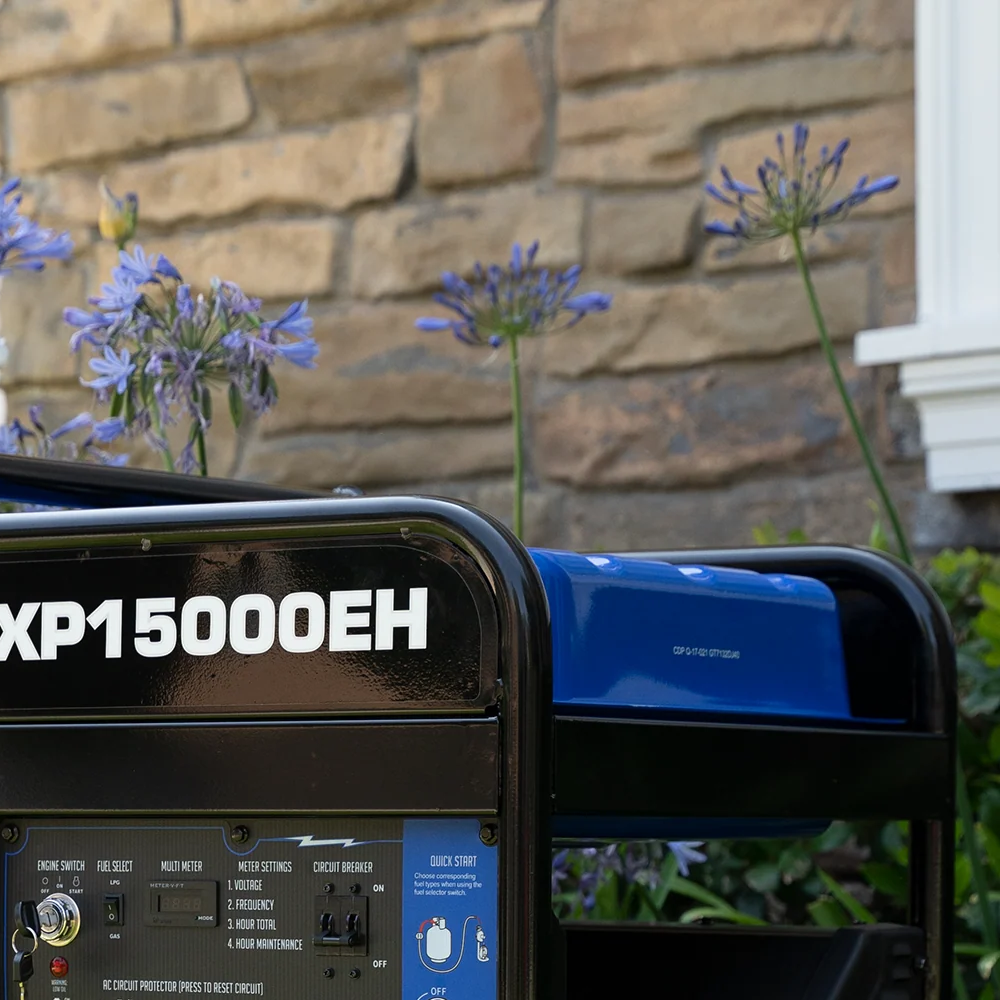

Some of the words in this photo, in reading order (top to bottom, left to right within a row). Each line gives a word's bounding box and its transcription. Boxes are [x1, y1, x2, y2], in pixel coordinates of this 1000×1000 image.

[38, 860, 59, 871] ENGINE
[60, 860, 85, 871] SWITCH
[97, 860, 111, 872] FUEL
[112, 860, 133, 872] SELECT
[161, 860, 180, 871] MULTI
[181, 860, 203, 872] METER
[238, 861, 260, 872] METER
[261, 861, 292, 872] SETTINGS
[313, 861, 340, 873] CIRCUIT
[342, 862, 373, 873] BREAKER
[430, 855, 452, 866] QUICK
[454, 856, 477, 867] START
[228, 880, 233, 891] 1.
[234, 880, 262, 891] VOLTAGE
[228, 899, 234, 910] 2.
[236, 899, 275, 911] FREQUENCY
[228, 919, 234, 930] 3.
[236, 919, 255, 930] HOUR
[256, 919, 276, 930] TOTAL
[228, 938, 234, 949] 4.
[236, 938, 255, 949] HOUR
[256, 939, 303, 950] MAINTENANCE
[103, 980, 112, 990] AC
[113, 980, 138, 991] CIRCUIT
[140, 980, 177, 992] PROTECTOR
[178, 980, 201, 993] (PRESS
[203, 982, 212, 993] TO
[214, 982, 233, 994] RESET
[235, 982, 264, 995] CIRCUIT)
[431, 987, 446, 995] OFF
